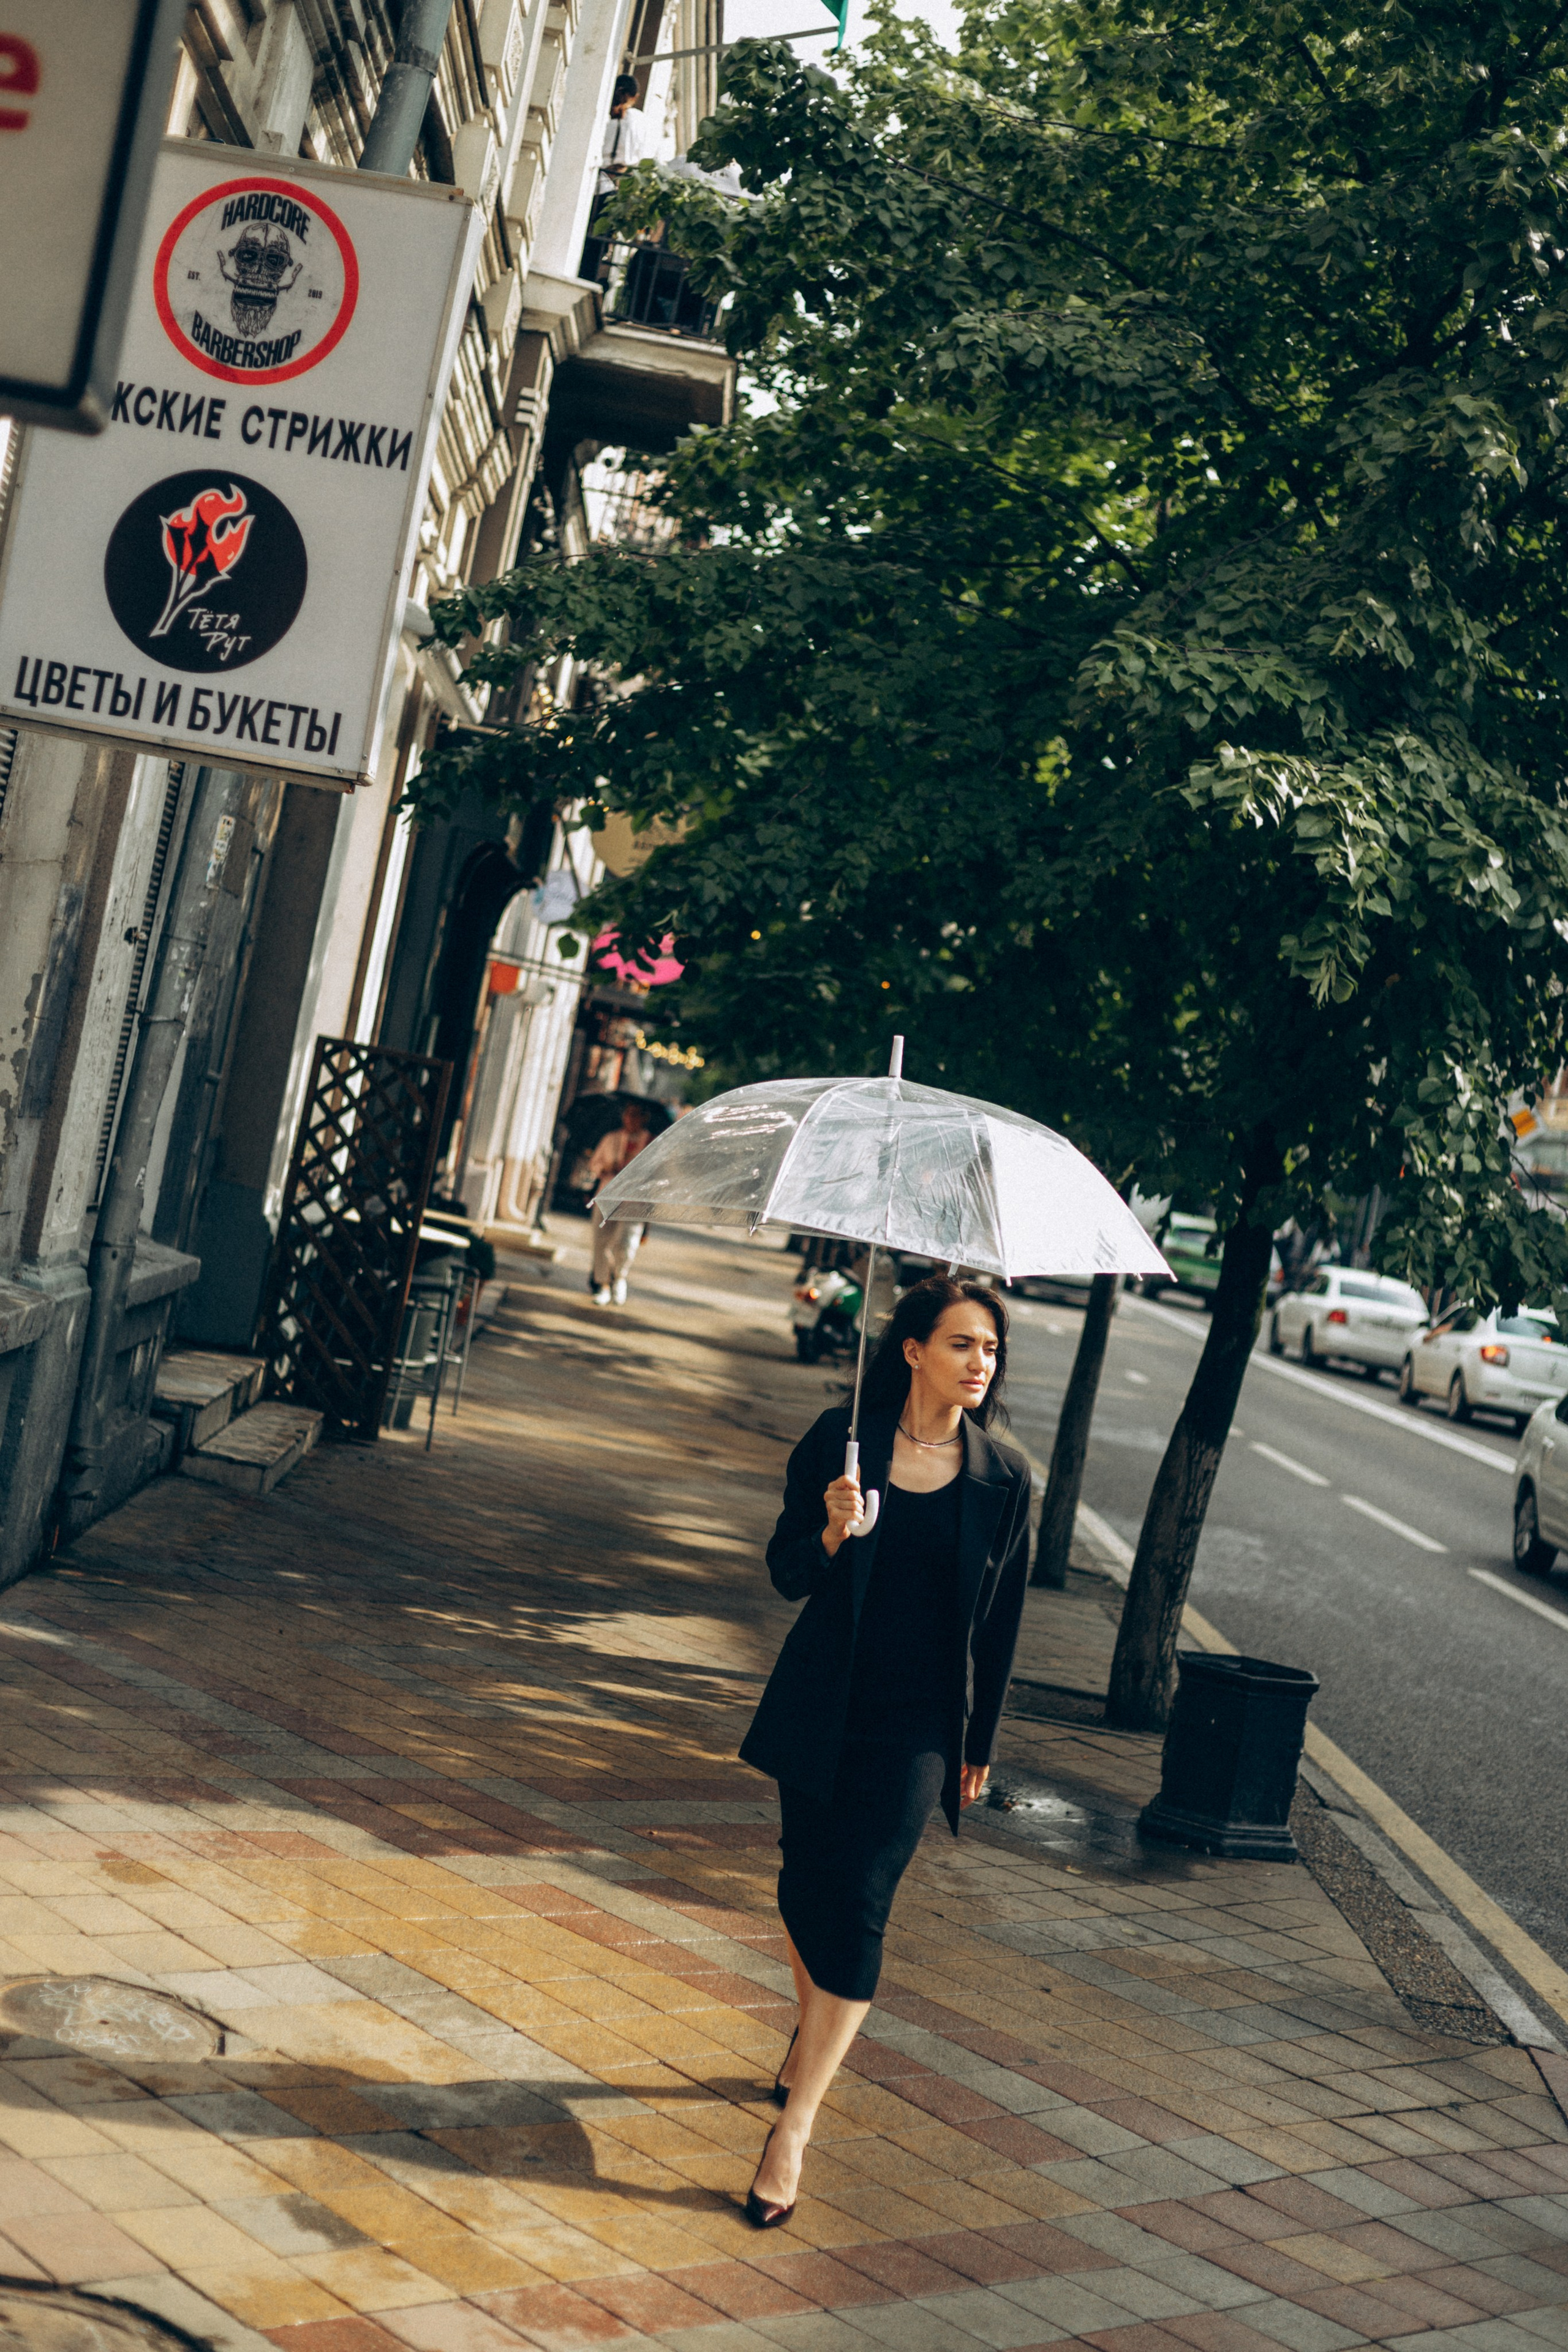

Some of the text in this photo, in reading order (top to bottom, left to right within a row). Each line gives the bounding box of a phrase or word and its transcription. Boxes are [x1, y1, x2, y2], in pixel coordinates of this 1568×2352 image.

[221, 193, 311, 245] HARDCORE
[187, 270, 201, 281] EST.
[191, 309, 302, 368] BARBERSHOP
[241, 405, 413, 470] СТРИЖКИ
[14, 655, 342, 755] ЦВЕТЫ И БУКЕТЫ
